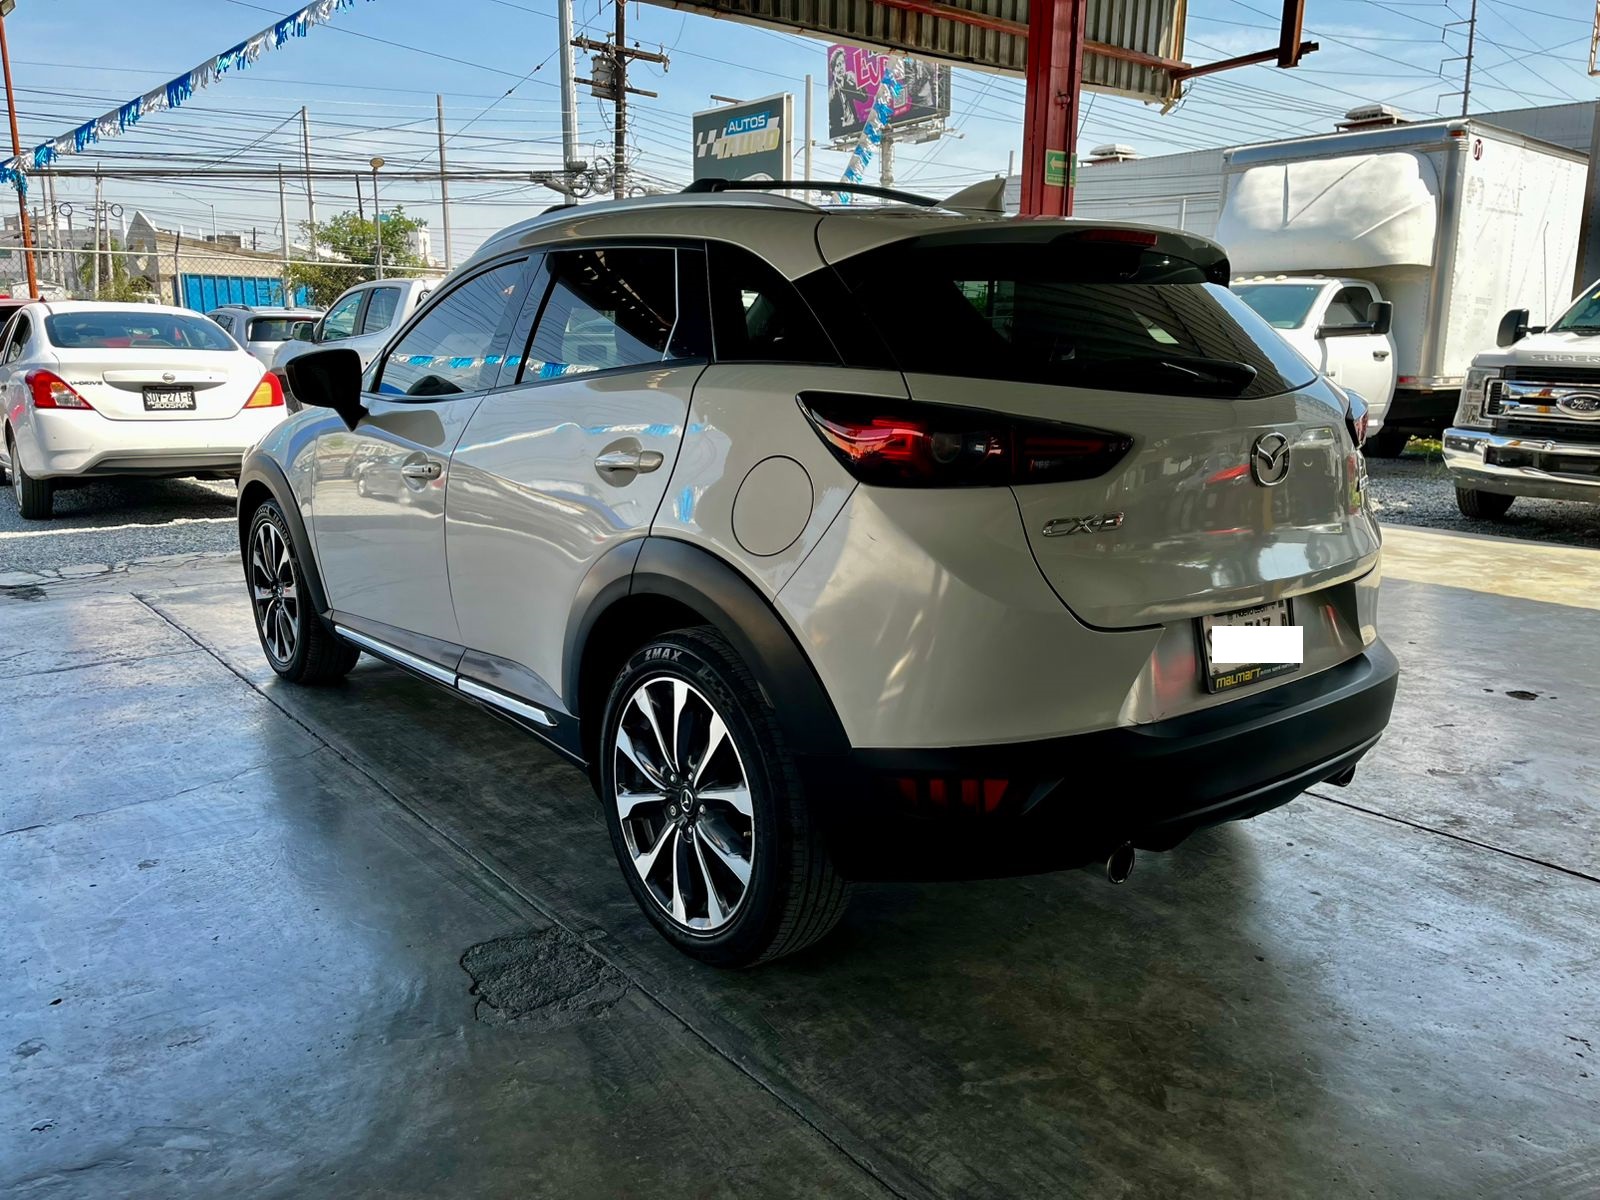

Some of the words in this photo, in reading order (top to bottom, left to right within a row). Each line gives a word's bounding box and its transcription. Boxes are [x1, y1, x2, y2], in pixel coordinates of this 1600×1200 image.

[728, 115, 766, 133] AUTOS
[1570, 398, 1599, 411] Ford
[1042, 511, 1124, 537] CX-3
[645, 647, 682, 662] ZMAX
